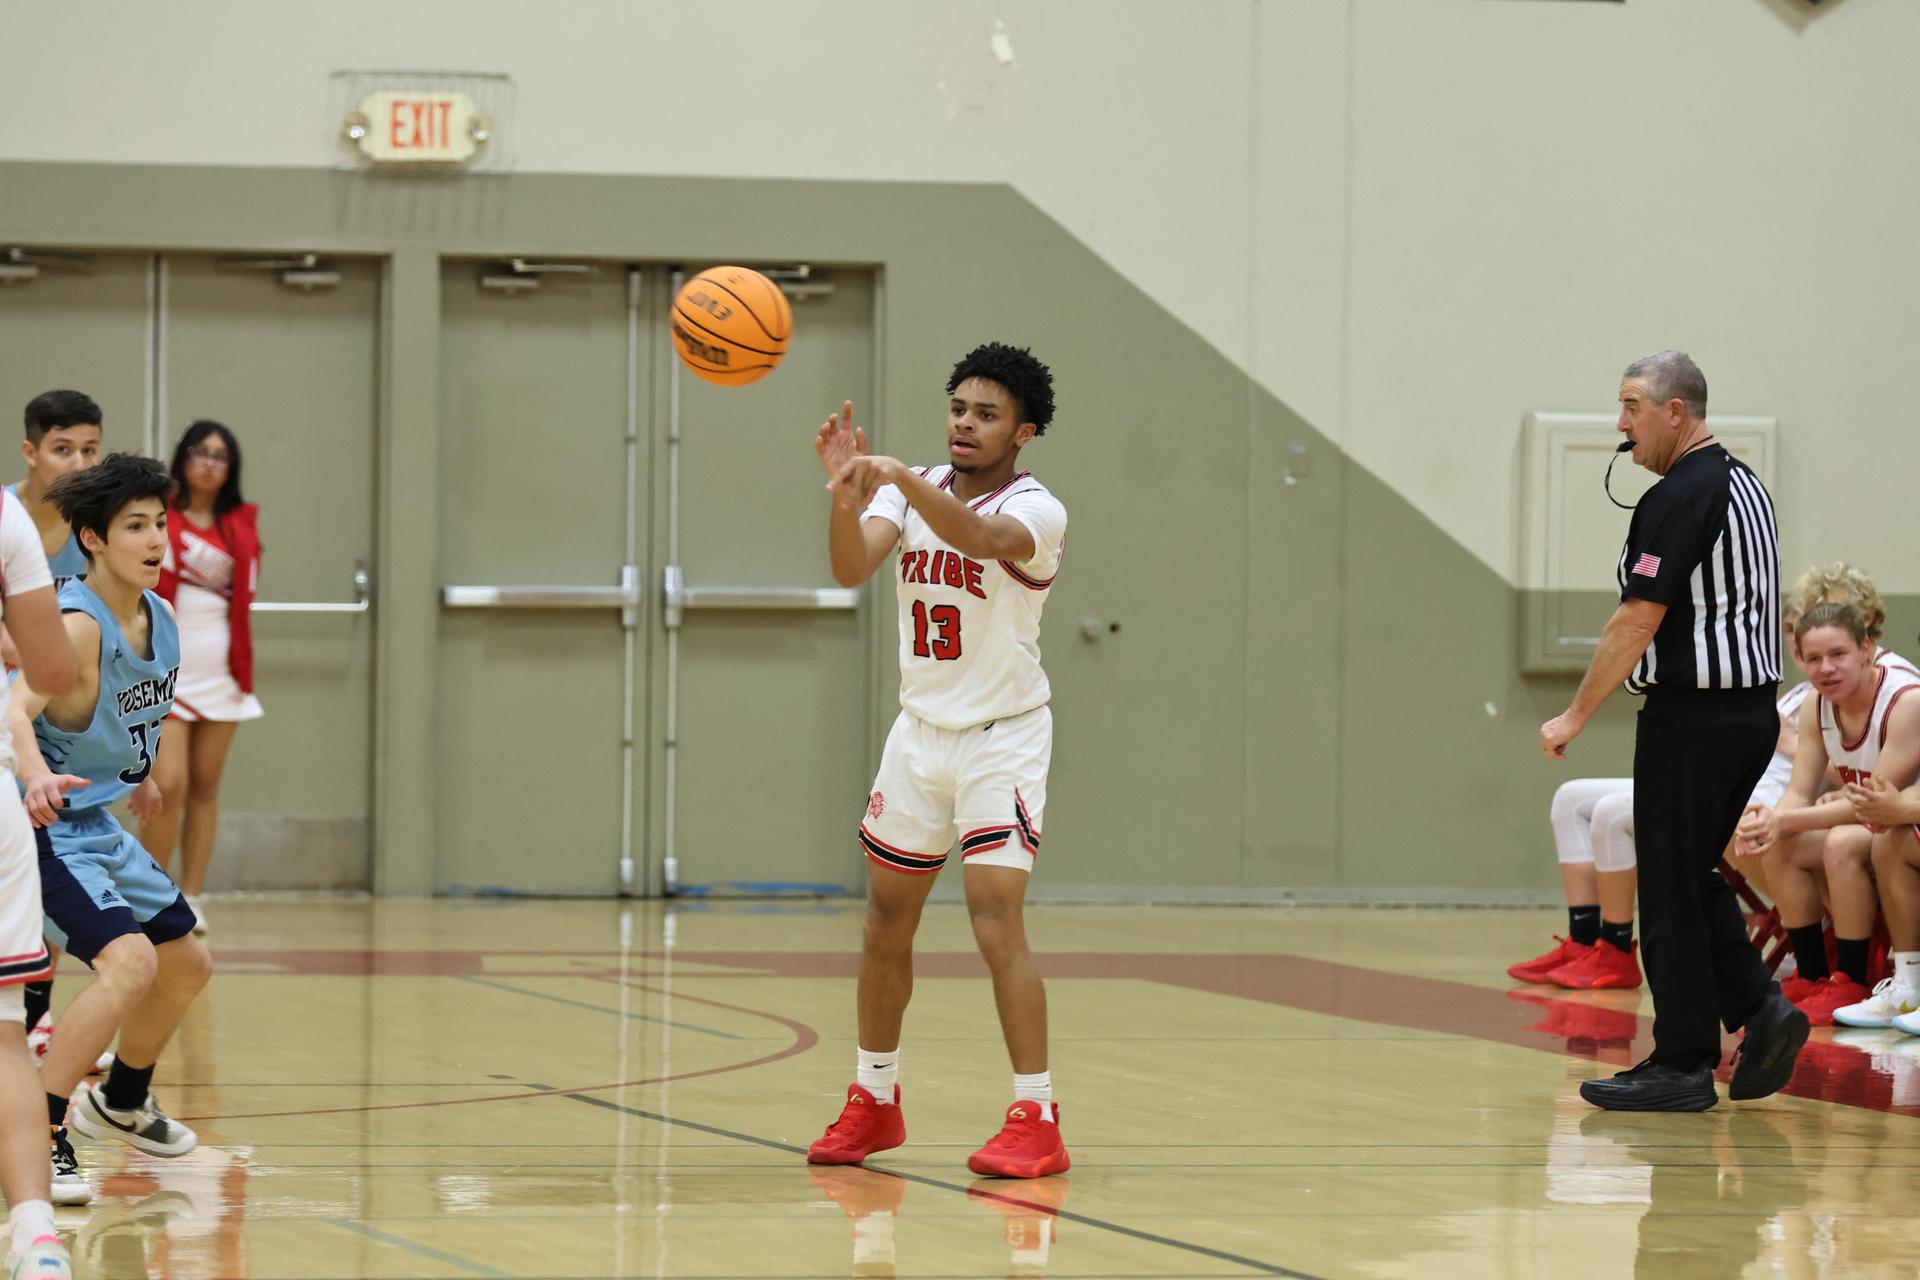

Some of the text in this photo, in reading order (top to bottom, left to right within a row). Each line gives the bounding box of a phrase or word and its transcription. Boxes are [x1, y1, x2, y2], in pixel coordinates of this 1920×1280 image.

[389, 99, 452, 149] EXIT
[901, 549, 987, 600] TRIBE
[911, 599, 963, 661] 13
